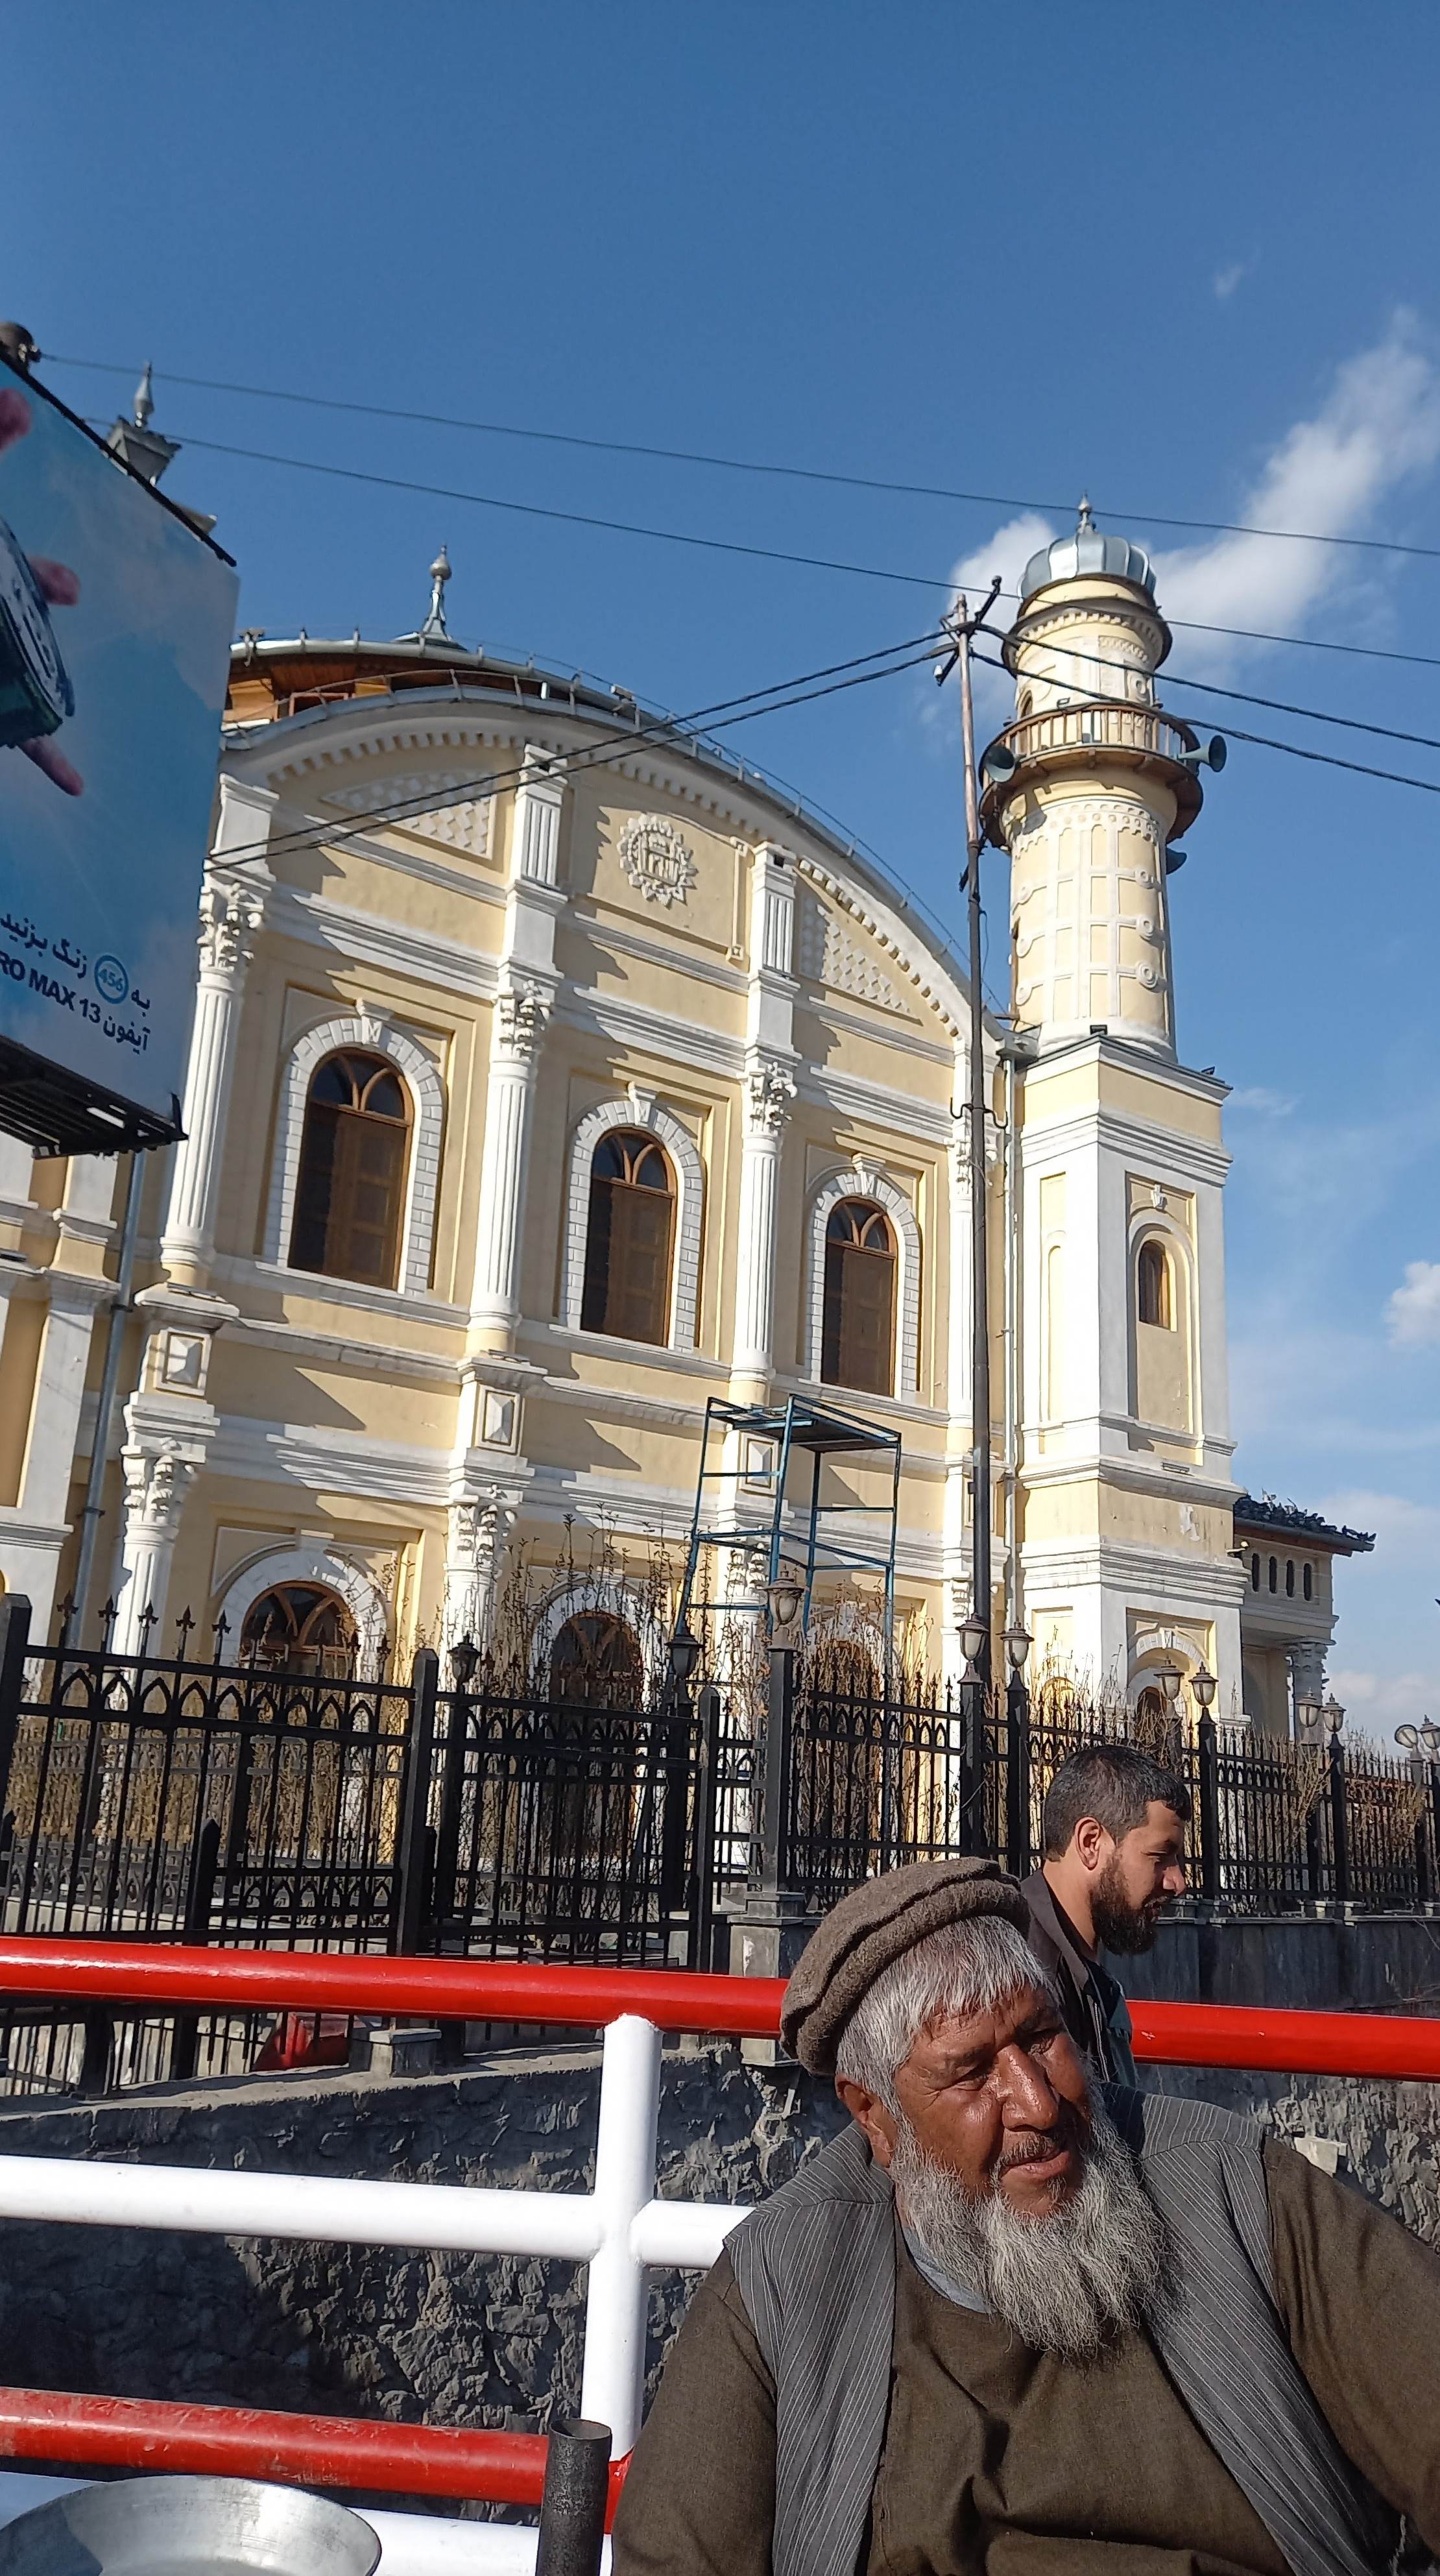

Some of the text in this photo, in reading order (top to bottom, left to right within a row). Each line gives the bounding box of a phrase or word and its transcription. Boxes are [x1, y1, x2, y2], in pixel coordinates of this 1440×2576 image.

[53, 938, 87, 979] زنگ
[29, 967, 77, 1012] MAX
[131, 989, 150, 1017] به
[79, 998, 101, 1024] 13
[103, 1015, 151, 1055] آیفون
